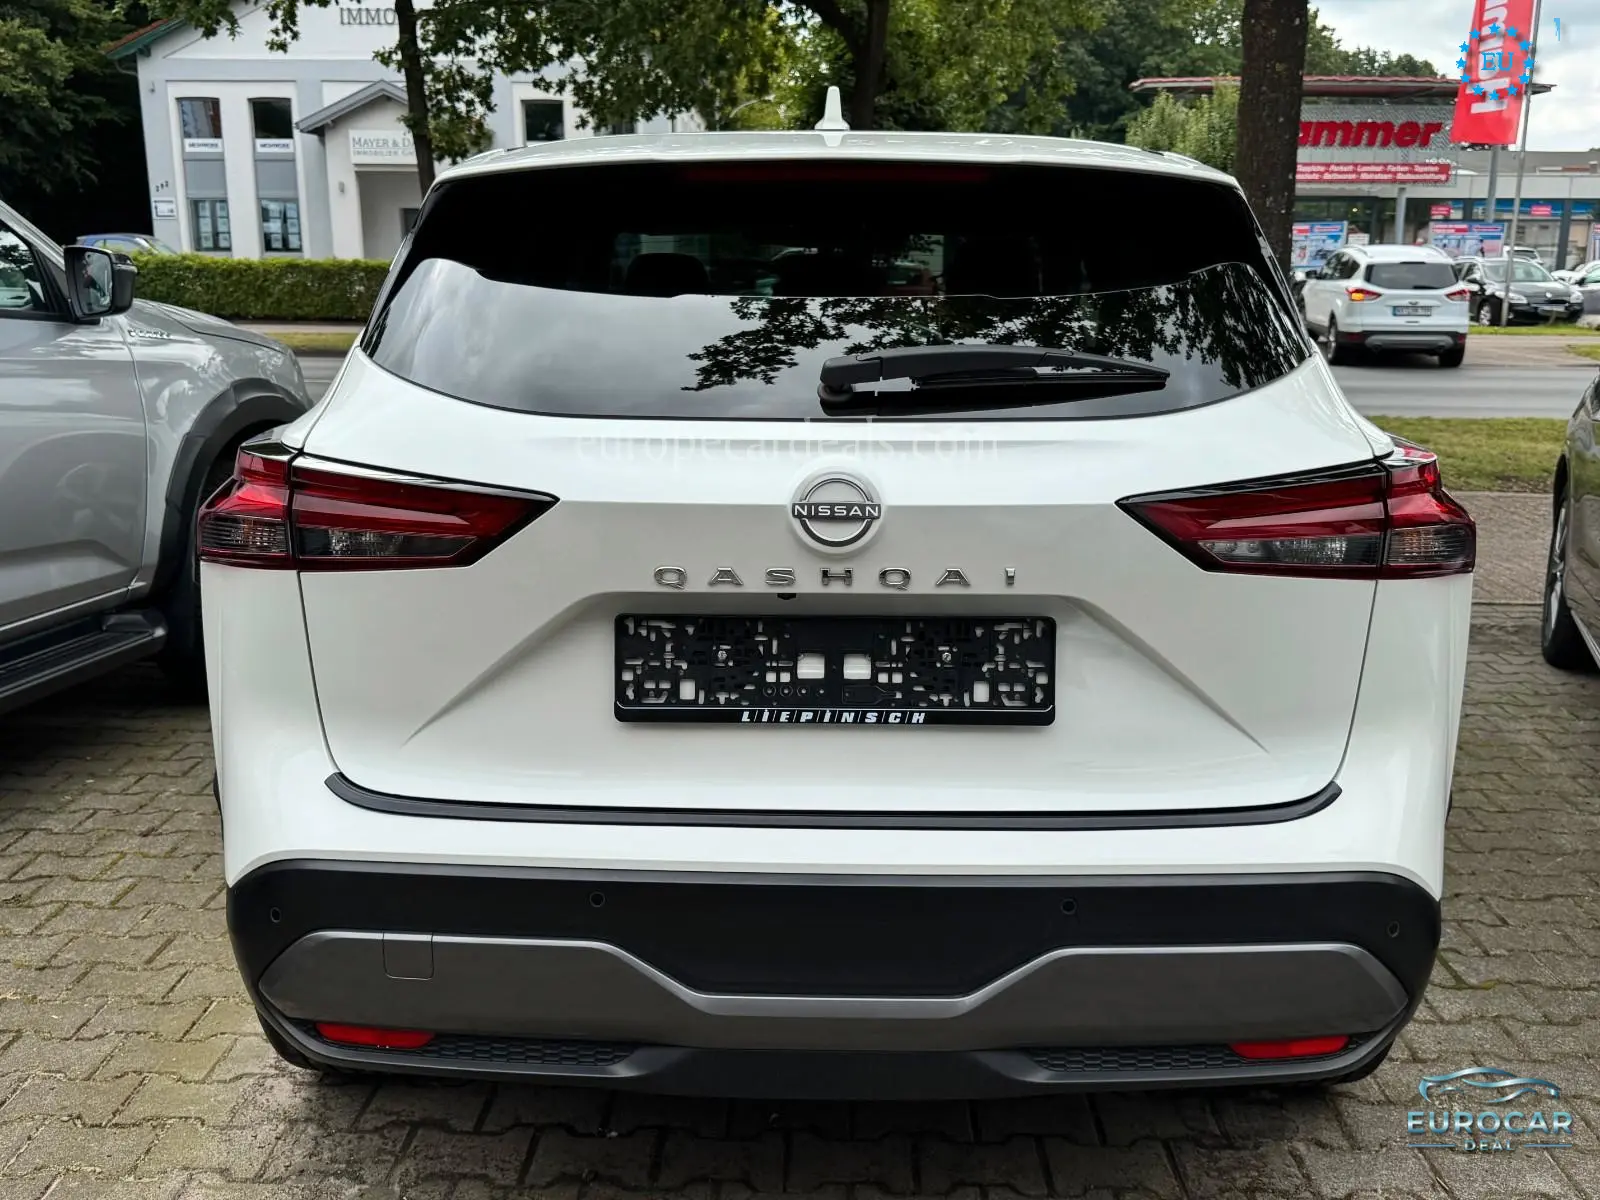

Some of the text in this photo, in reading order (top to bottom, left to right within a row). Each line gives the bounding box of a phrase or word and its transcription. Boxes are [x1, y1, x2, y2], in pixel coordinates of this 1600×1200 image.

[352, 137, 389, 148] MAYER
[392, 138, 400, 148] &
[794, 504, 879, 517] NISSAN
[653, 565, 1017, 591] QASHQAI
